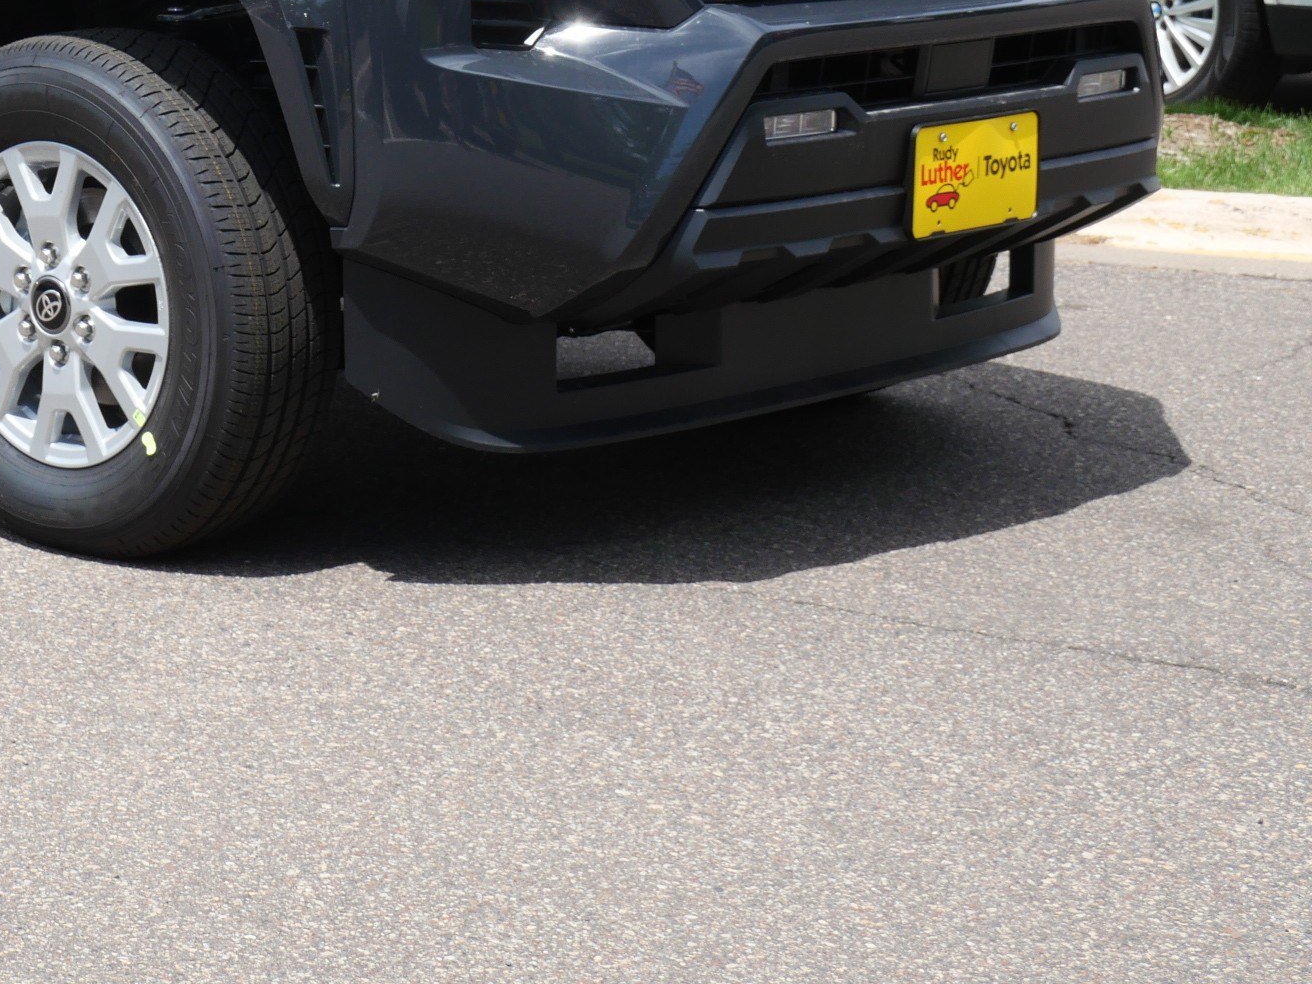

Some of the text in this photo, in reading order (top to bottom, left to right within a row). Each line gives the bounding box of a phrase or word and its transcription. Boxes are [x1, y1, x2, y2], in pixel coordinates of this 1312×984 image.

[932, 145, 959, 163] Rudy
[983, 150, 1031, 179] Toyota
[921, 160, 970, 187] Luther
